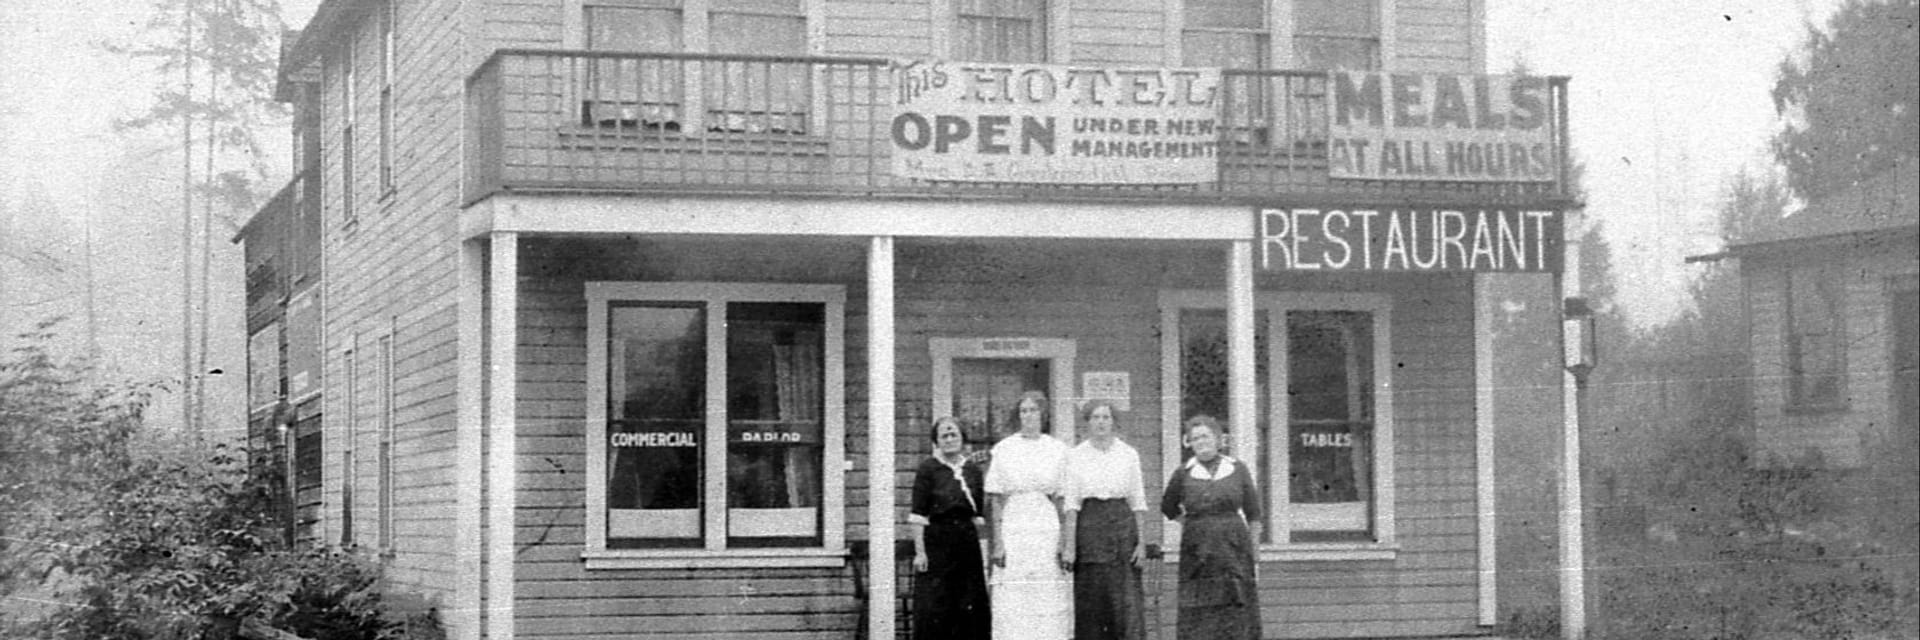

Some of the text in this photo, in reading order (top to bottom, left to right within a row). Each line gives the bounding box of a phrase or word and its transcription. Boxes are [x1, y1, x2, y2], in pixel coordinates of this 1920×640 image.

[960, 67, 1217, 106] HOTEL
[1335, 72, 1547, 130] MEALS
[891, 112, 1055, 155] OPEN
[1072, 118, 1215, 136] UNDER NEW
[1071, 139, 1217, 159] MANAGEMENT
[1330, 138, 1549, 178] AT ALL HOURS
[1260, 208, 1554, 269] RESTAURANT
[611, 432, 697, 447] COMMERCIAL
[1301, 433, 1352, 447] TABLES
